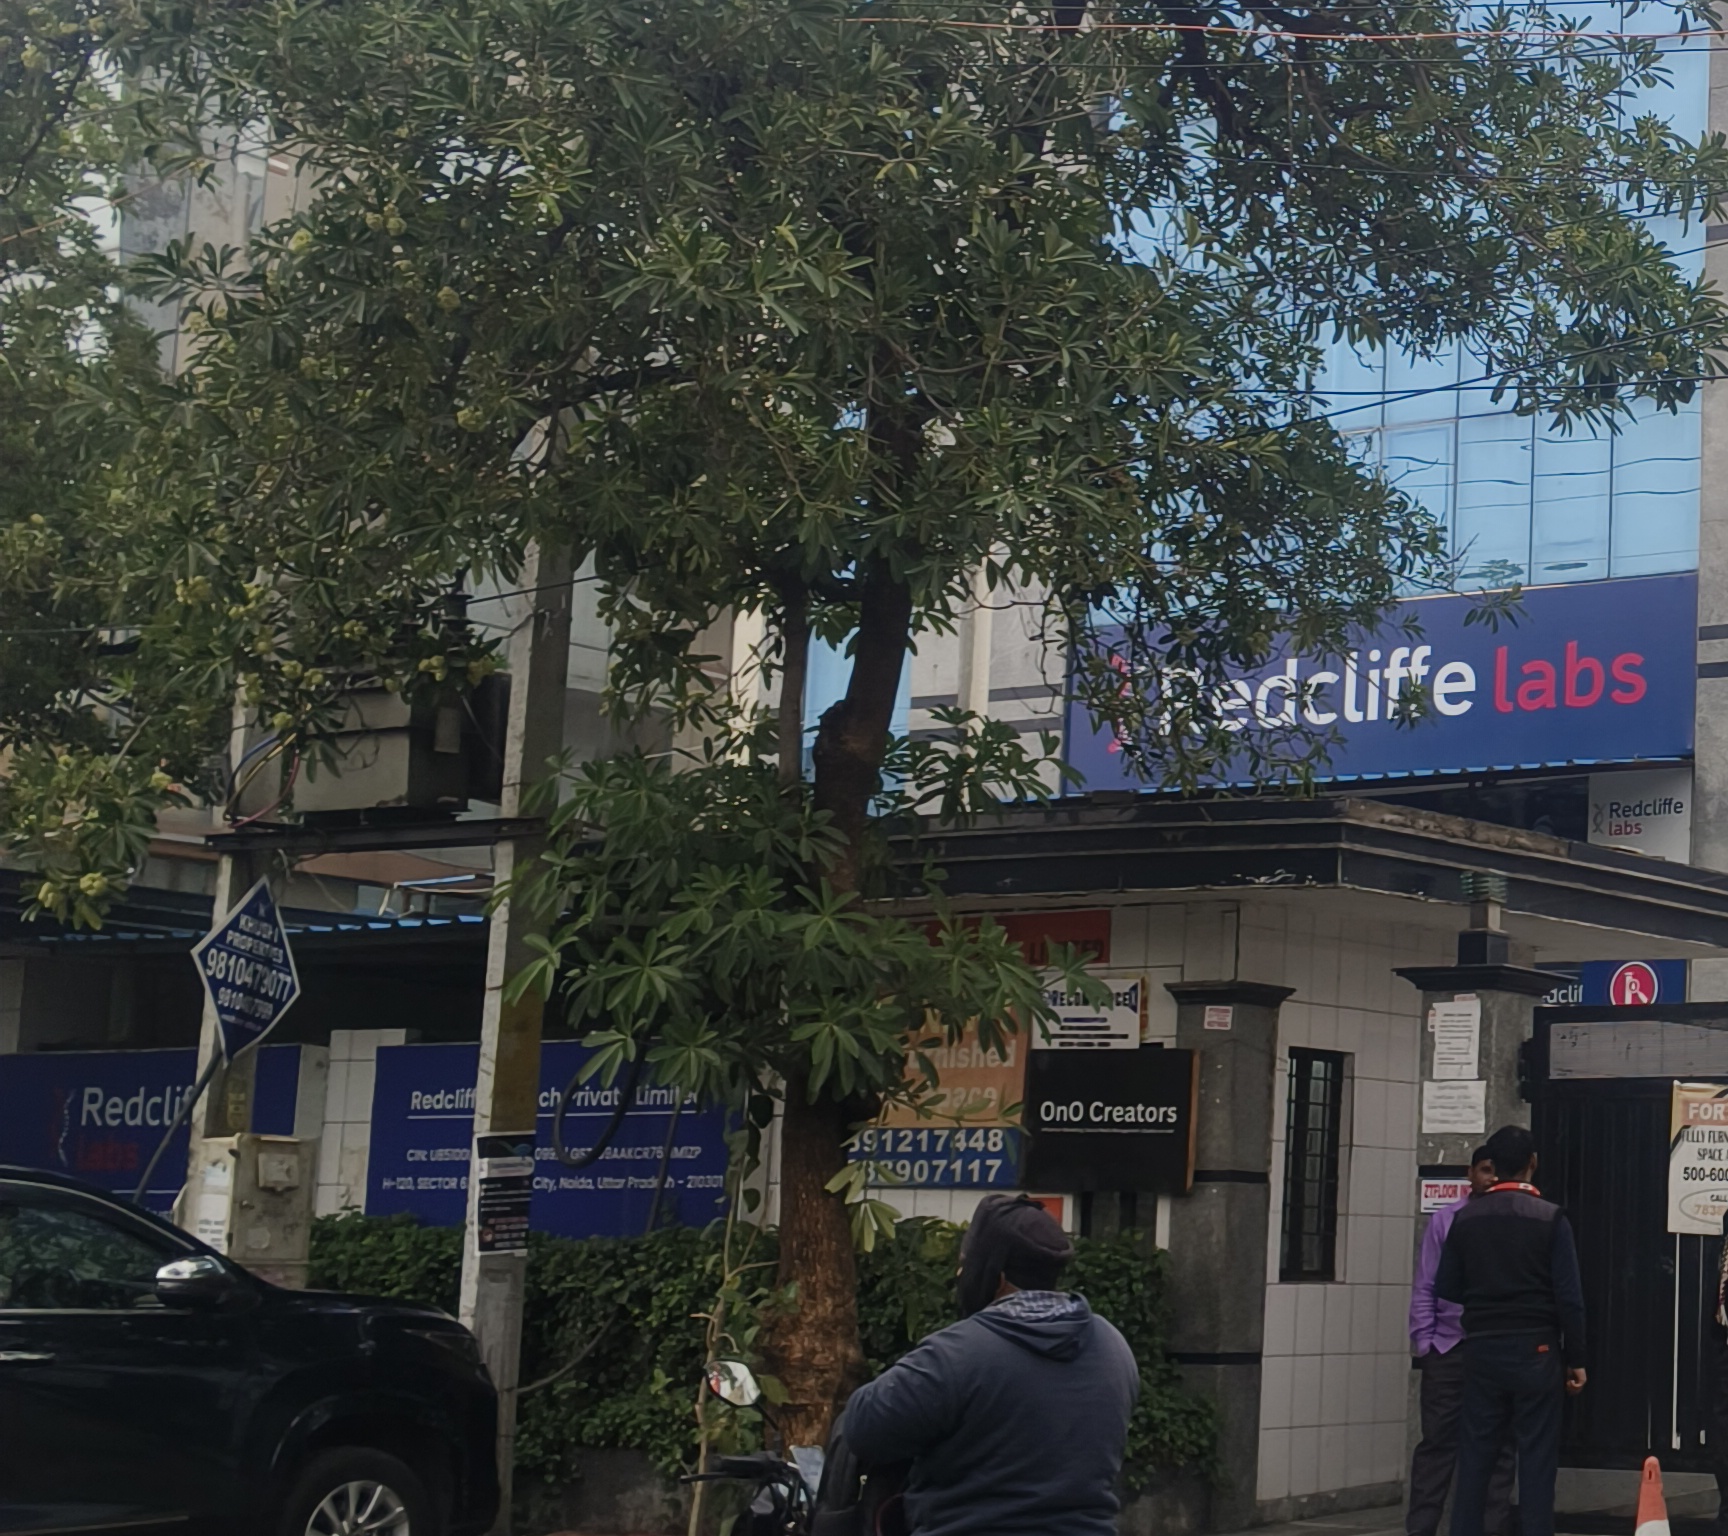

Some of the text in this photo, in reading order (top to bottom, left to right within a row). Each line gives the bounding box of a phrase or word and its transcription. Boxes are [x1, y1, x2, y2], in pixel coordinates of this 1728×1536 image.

[1492, 641, 1648, 713] labs
[1609, 797, 1684, 819] Redcliffe
[1608, 820, 1643, 836] labs
[1040, 1099, 1178, 1126] OnO Creators
[1688, 1102, 1725, 1121] FOR
